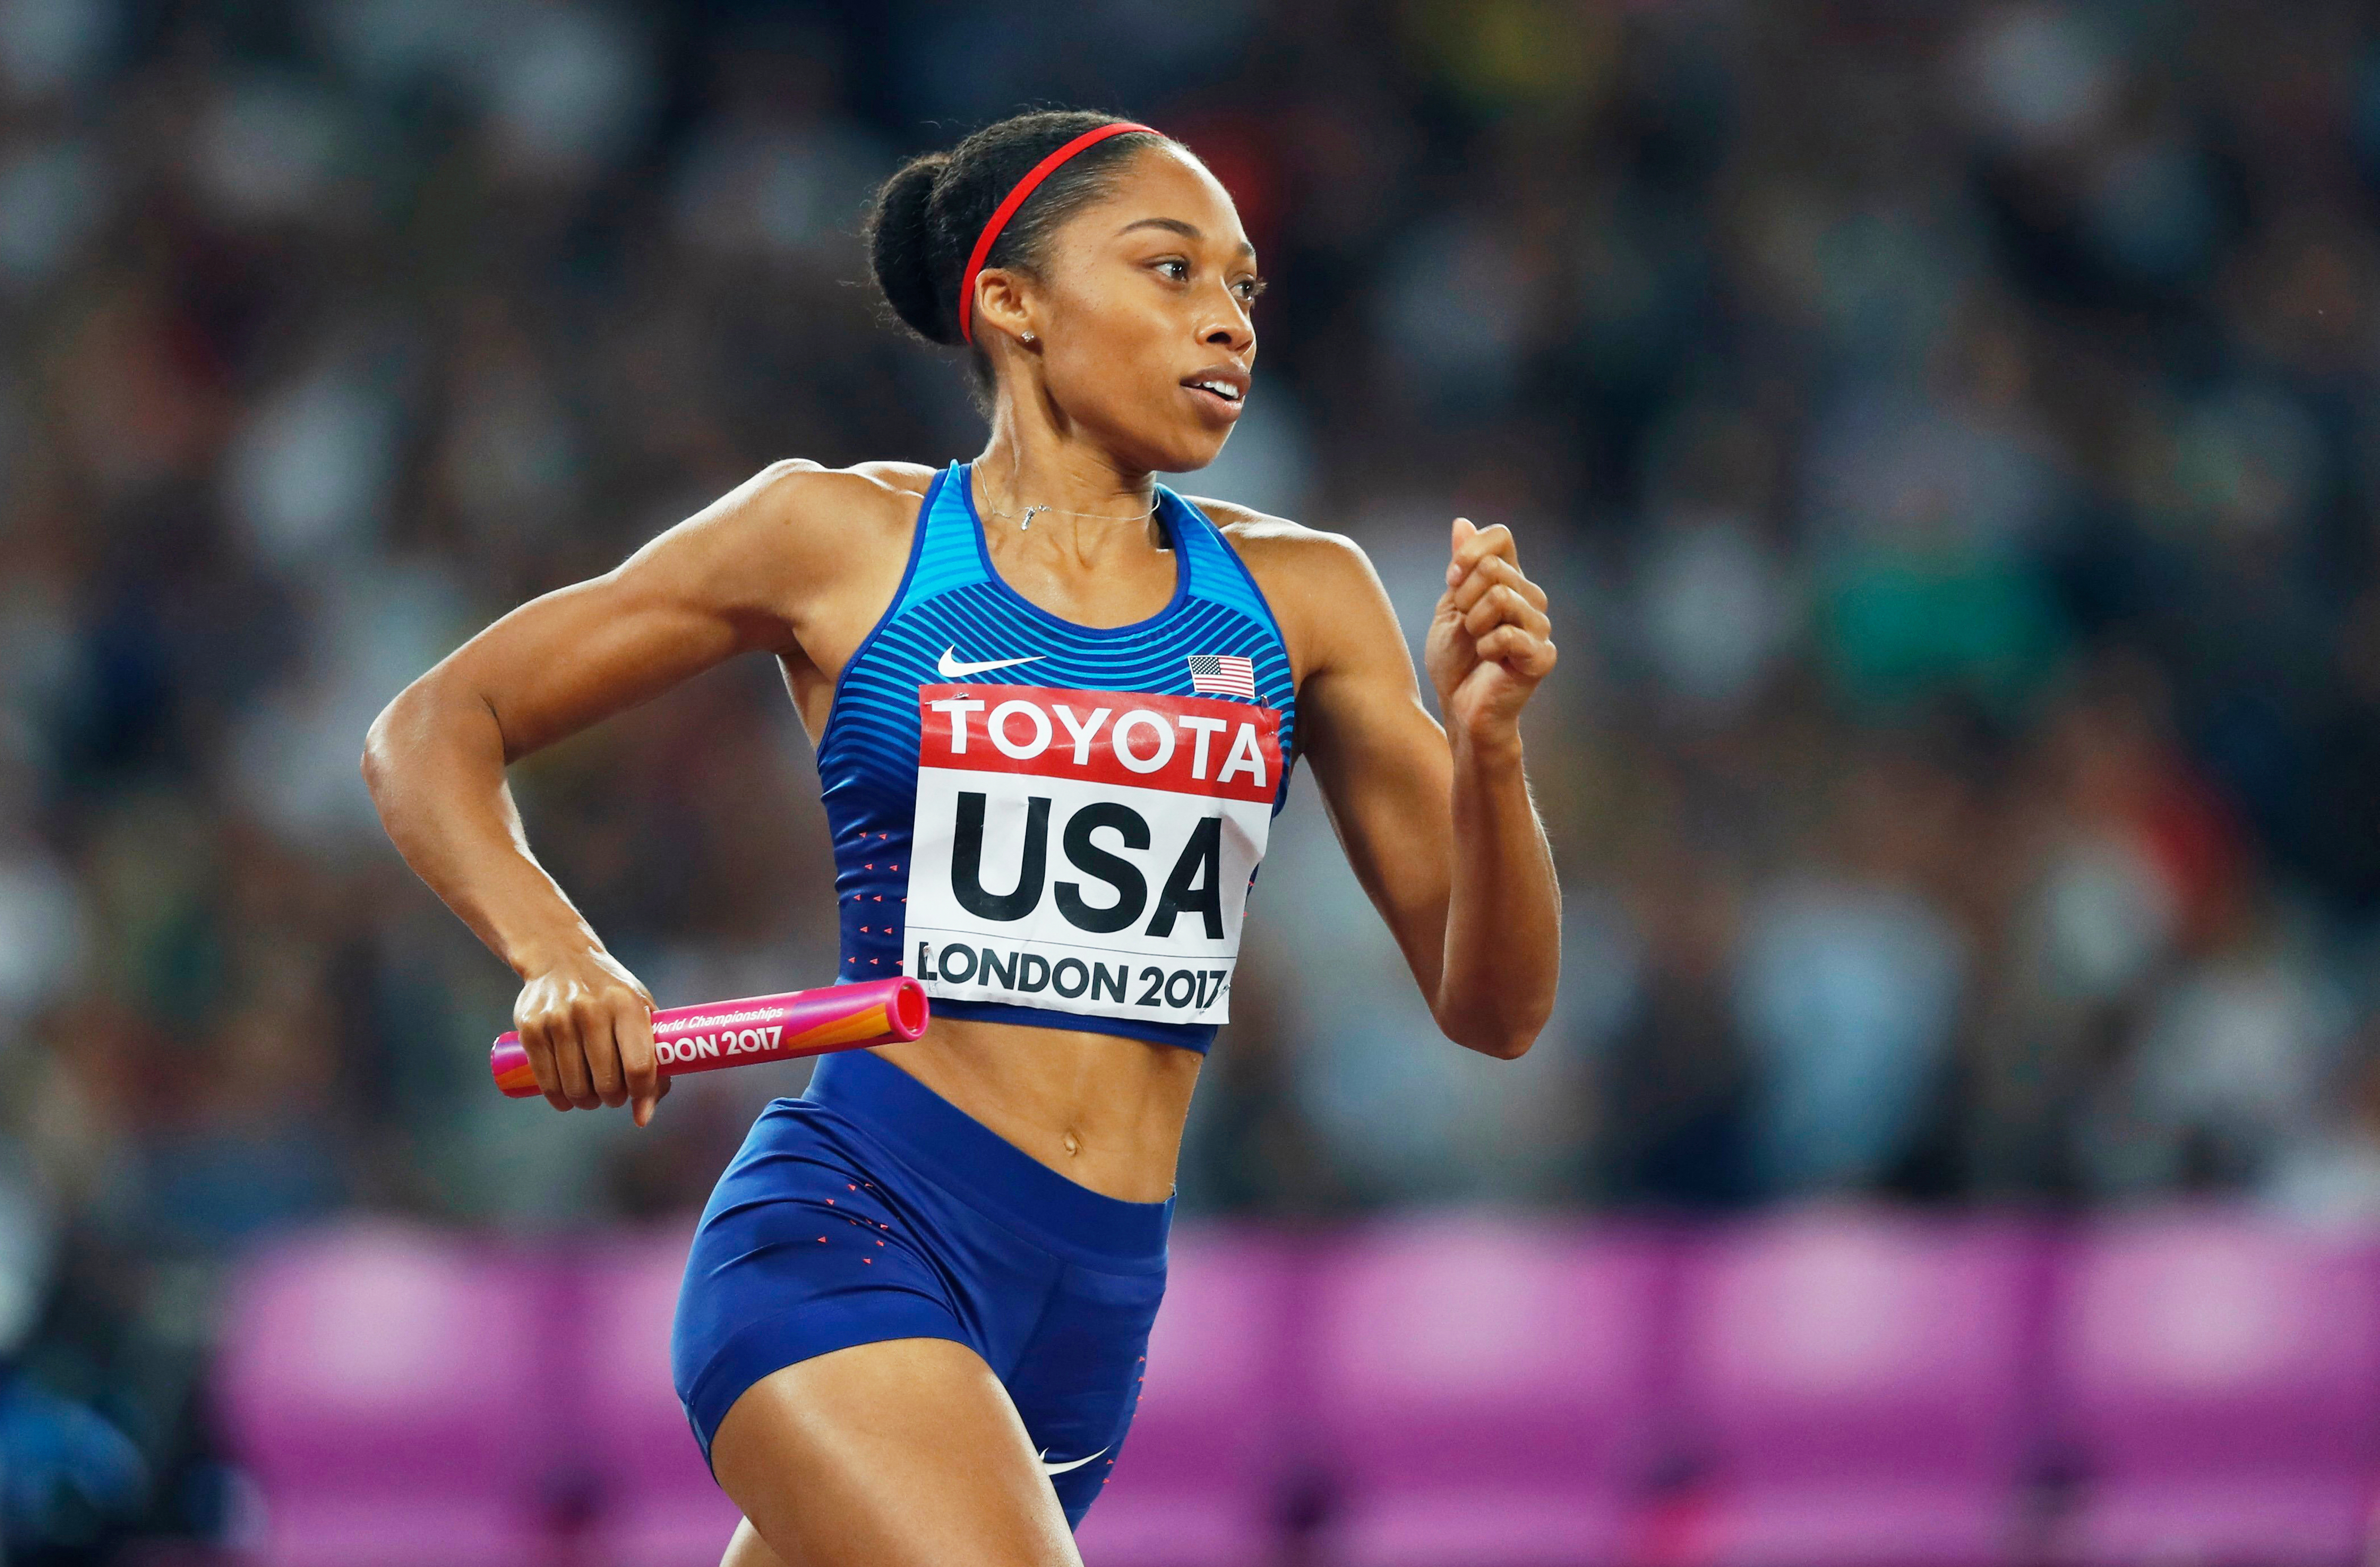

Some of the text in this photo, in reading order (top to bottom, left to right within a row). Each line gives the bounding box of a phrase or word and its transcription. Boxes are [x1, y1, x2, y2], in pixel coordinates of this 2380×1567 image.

[932, 699, 1266, 787] TOYOTA
[950, 791, 1225, 939] USA
[917, 941, 1227, 1008] LONDON 2017
[655, 1025, 783, 1065] DON 2017
[688, 1007, 784, 1029] Championships
